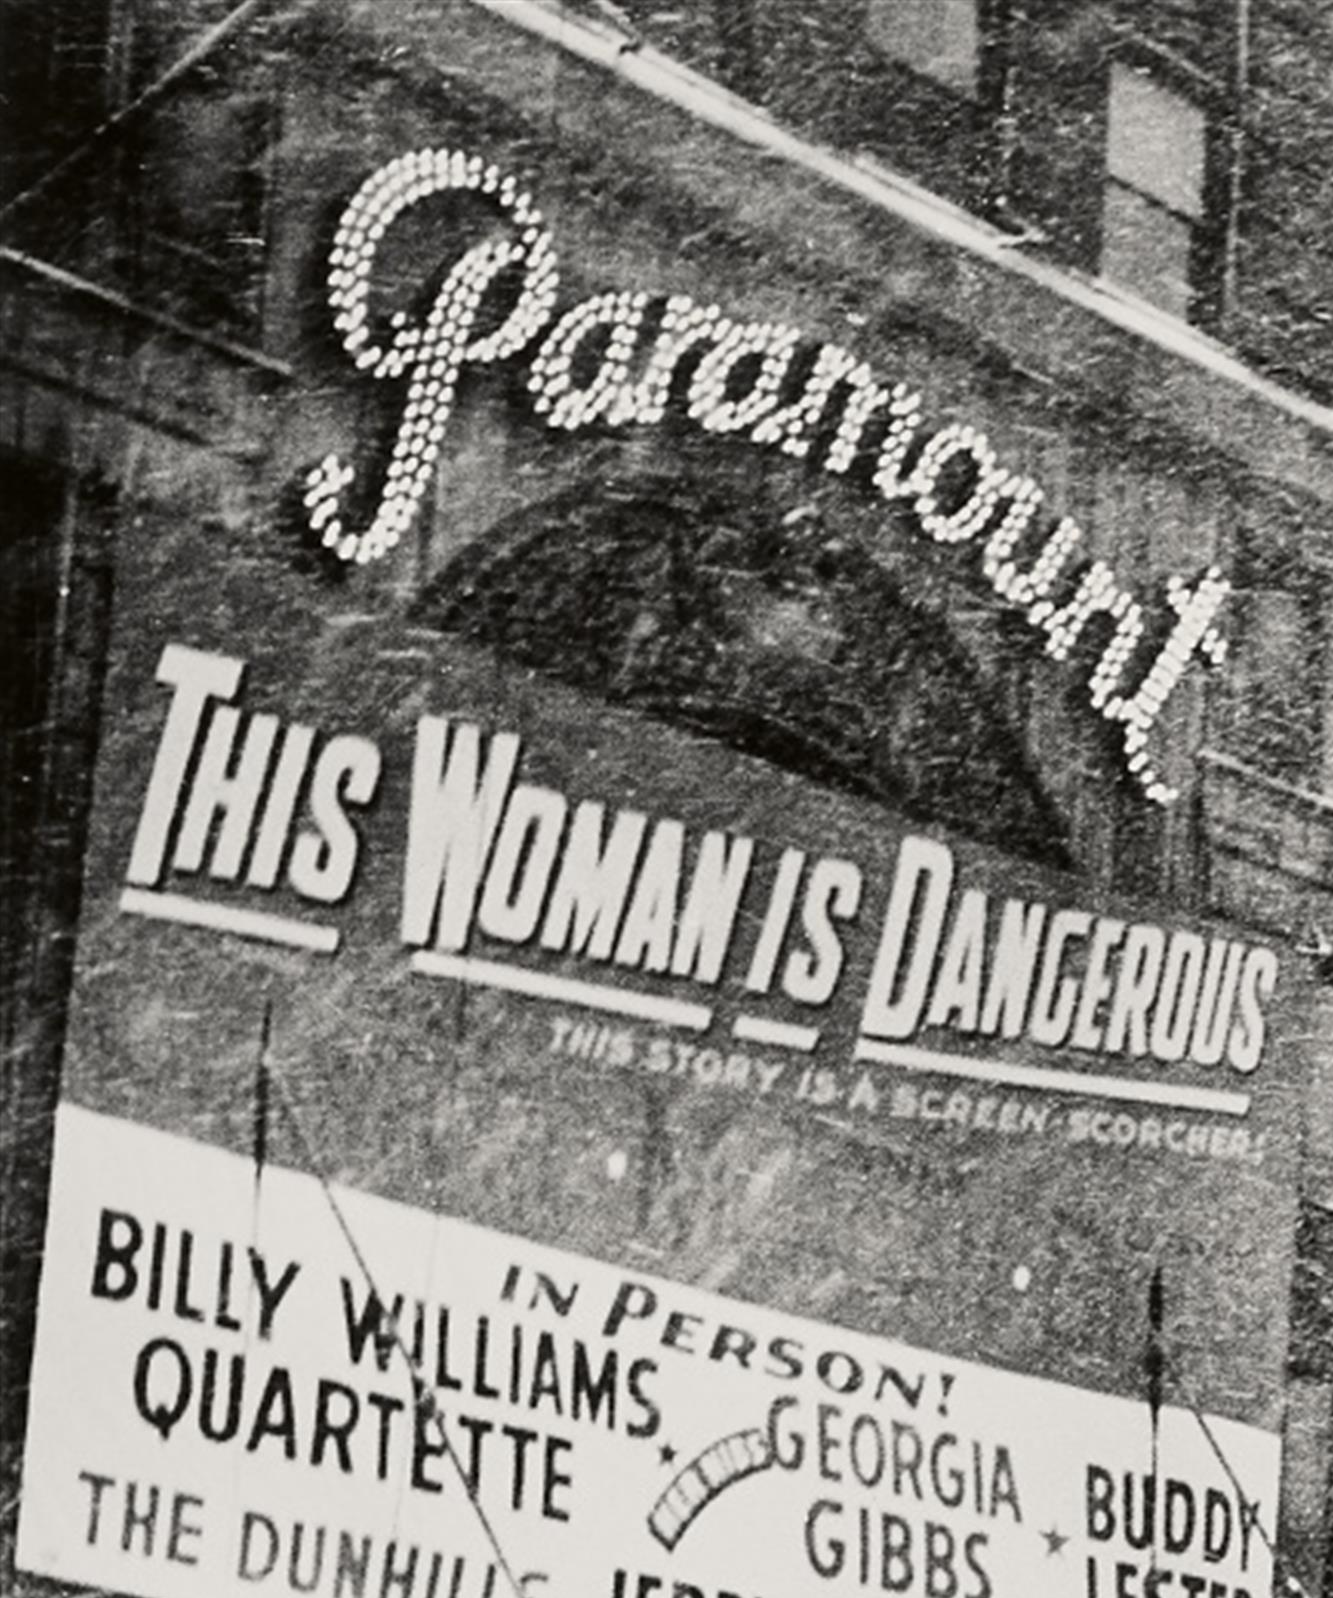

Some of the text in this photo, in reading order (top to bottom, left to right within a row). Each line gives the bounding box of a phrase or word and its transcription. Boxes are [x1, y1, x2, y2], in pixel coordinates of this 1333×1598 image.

[305, 147, 1231, 804] Paramount
[126, 644, 1280, 1073] THIS WOMAN IS DANGEROUS
[549, 1015, 634, 1066] THIS
[643, 1040, 783, 1094] STORY
[798, 1063, 838, 1105] IS
[848, 1071, 878, 1112] A
[91, 1208, 662, 1439] BILLY WILLIAMS
[501, 1265, 957, 1418] IN PERSON!
[134, 1338, 574, 1522] QUARTETTE
[766, 1394, 1023, 1523] GEORGIA
[79, 1471, 203, 1566] THE
[1086, 1463, 1263, 1573] BUDDY
